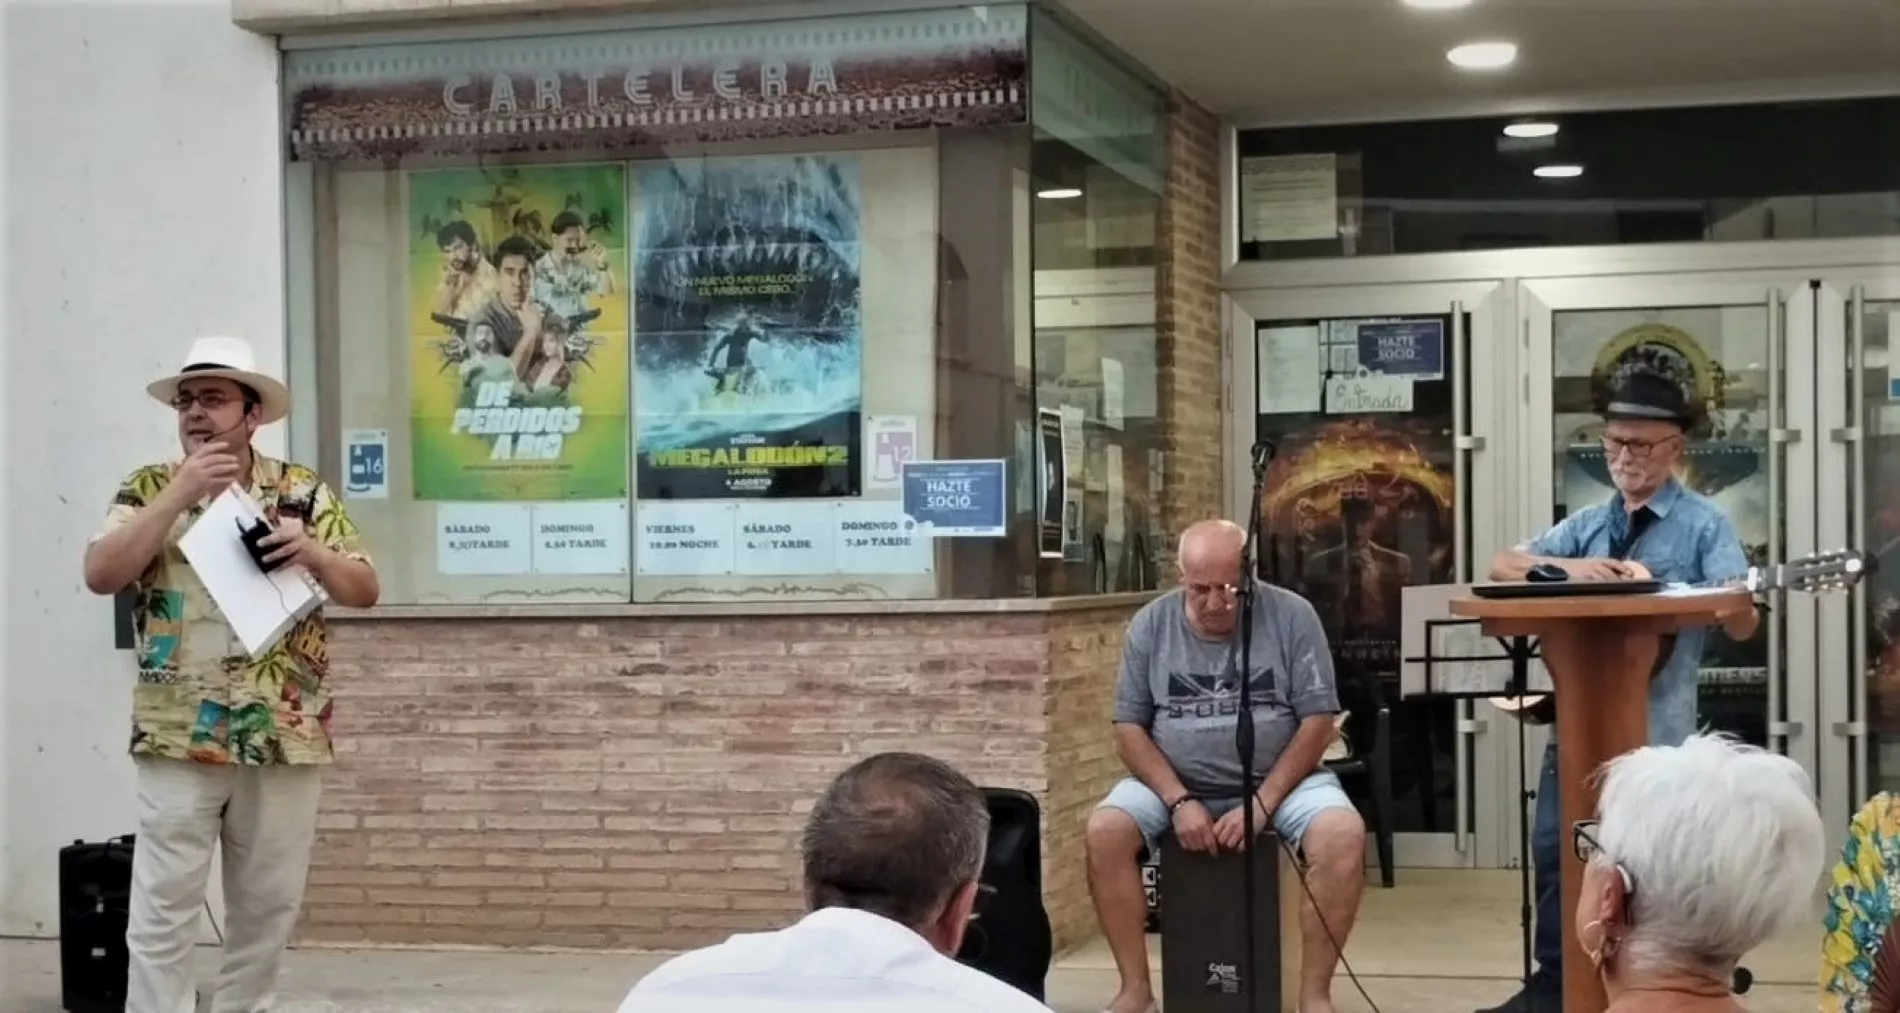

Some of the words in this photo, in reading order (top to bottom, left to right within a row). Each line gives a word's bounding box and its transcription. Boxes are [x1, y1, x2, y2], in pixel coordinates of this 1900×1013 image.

[443, 59, 838, 115] CARTELERA
[1378, 336, 1415, 347] HAZTE
[1378, 348, 1416, 360] SOCIO
[476, 381, 513, 407] DE
[452, 406, 583, 435] PERDIDOS
[490, 434, 512, 460] A
[893, 444, 912, 463] 12
[366, 457, 384, 476] 16
[926, 479, 972, 493] HAZTE
[926, 495, 972, 509] SOCIO
[541, 524, 593, 533] DOMINGO
[646, 525, 695, 534] VIERNES
[842, 522, 897, 530] DOMINGO
[470, 540, 509, 548] TARDE
[569, 540, 606, 548] TARDE
[679, 540, 719, 548] NOCHE
[771, 540, 812, 548] TARDE
[870, 537, 911, 546] TARDE
